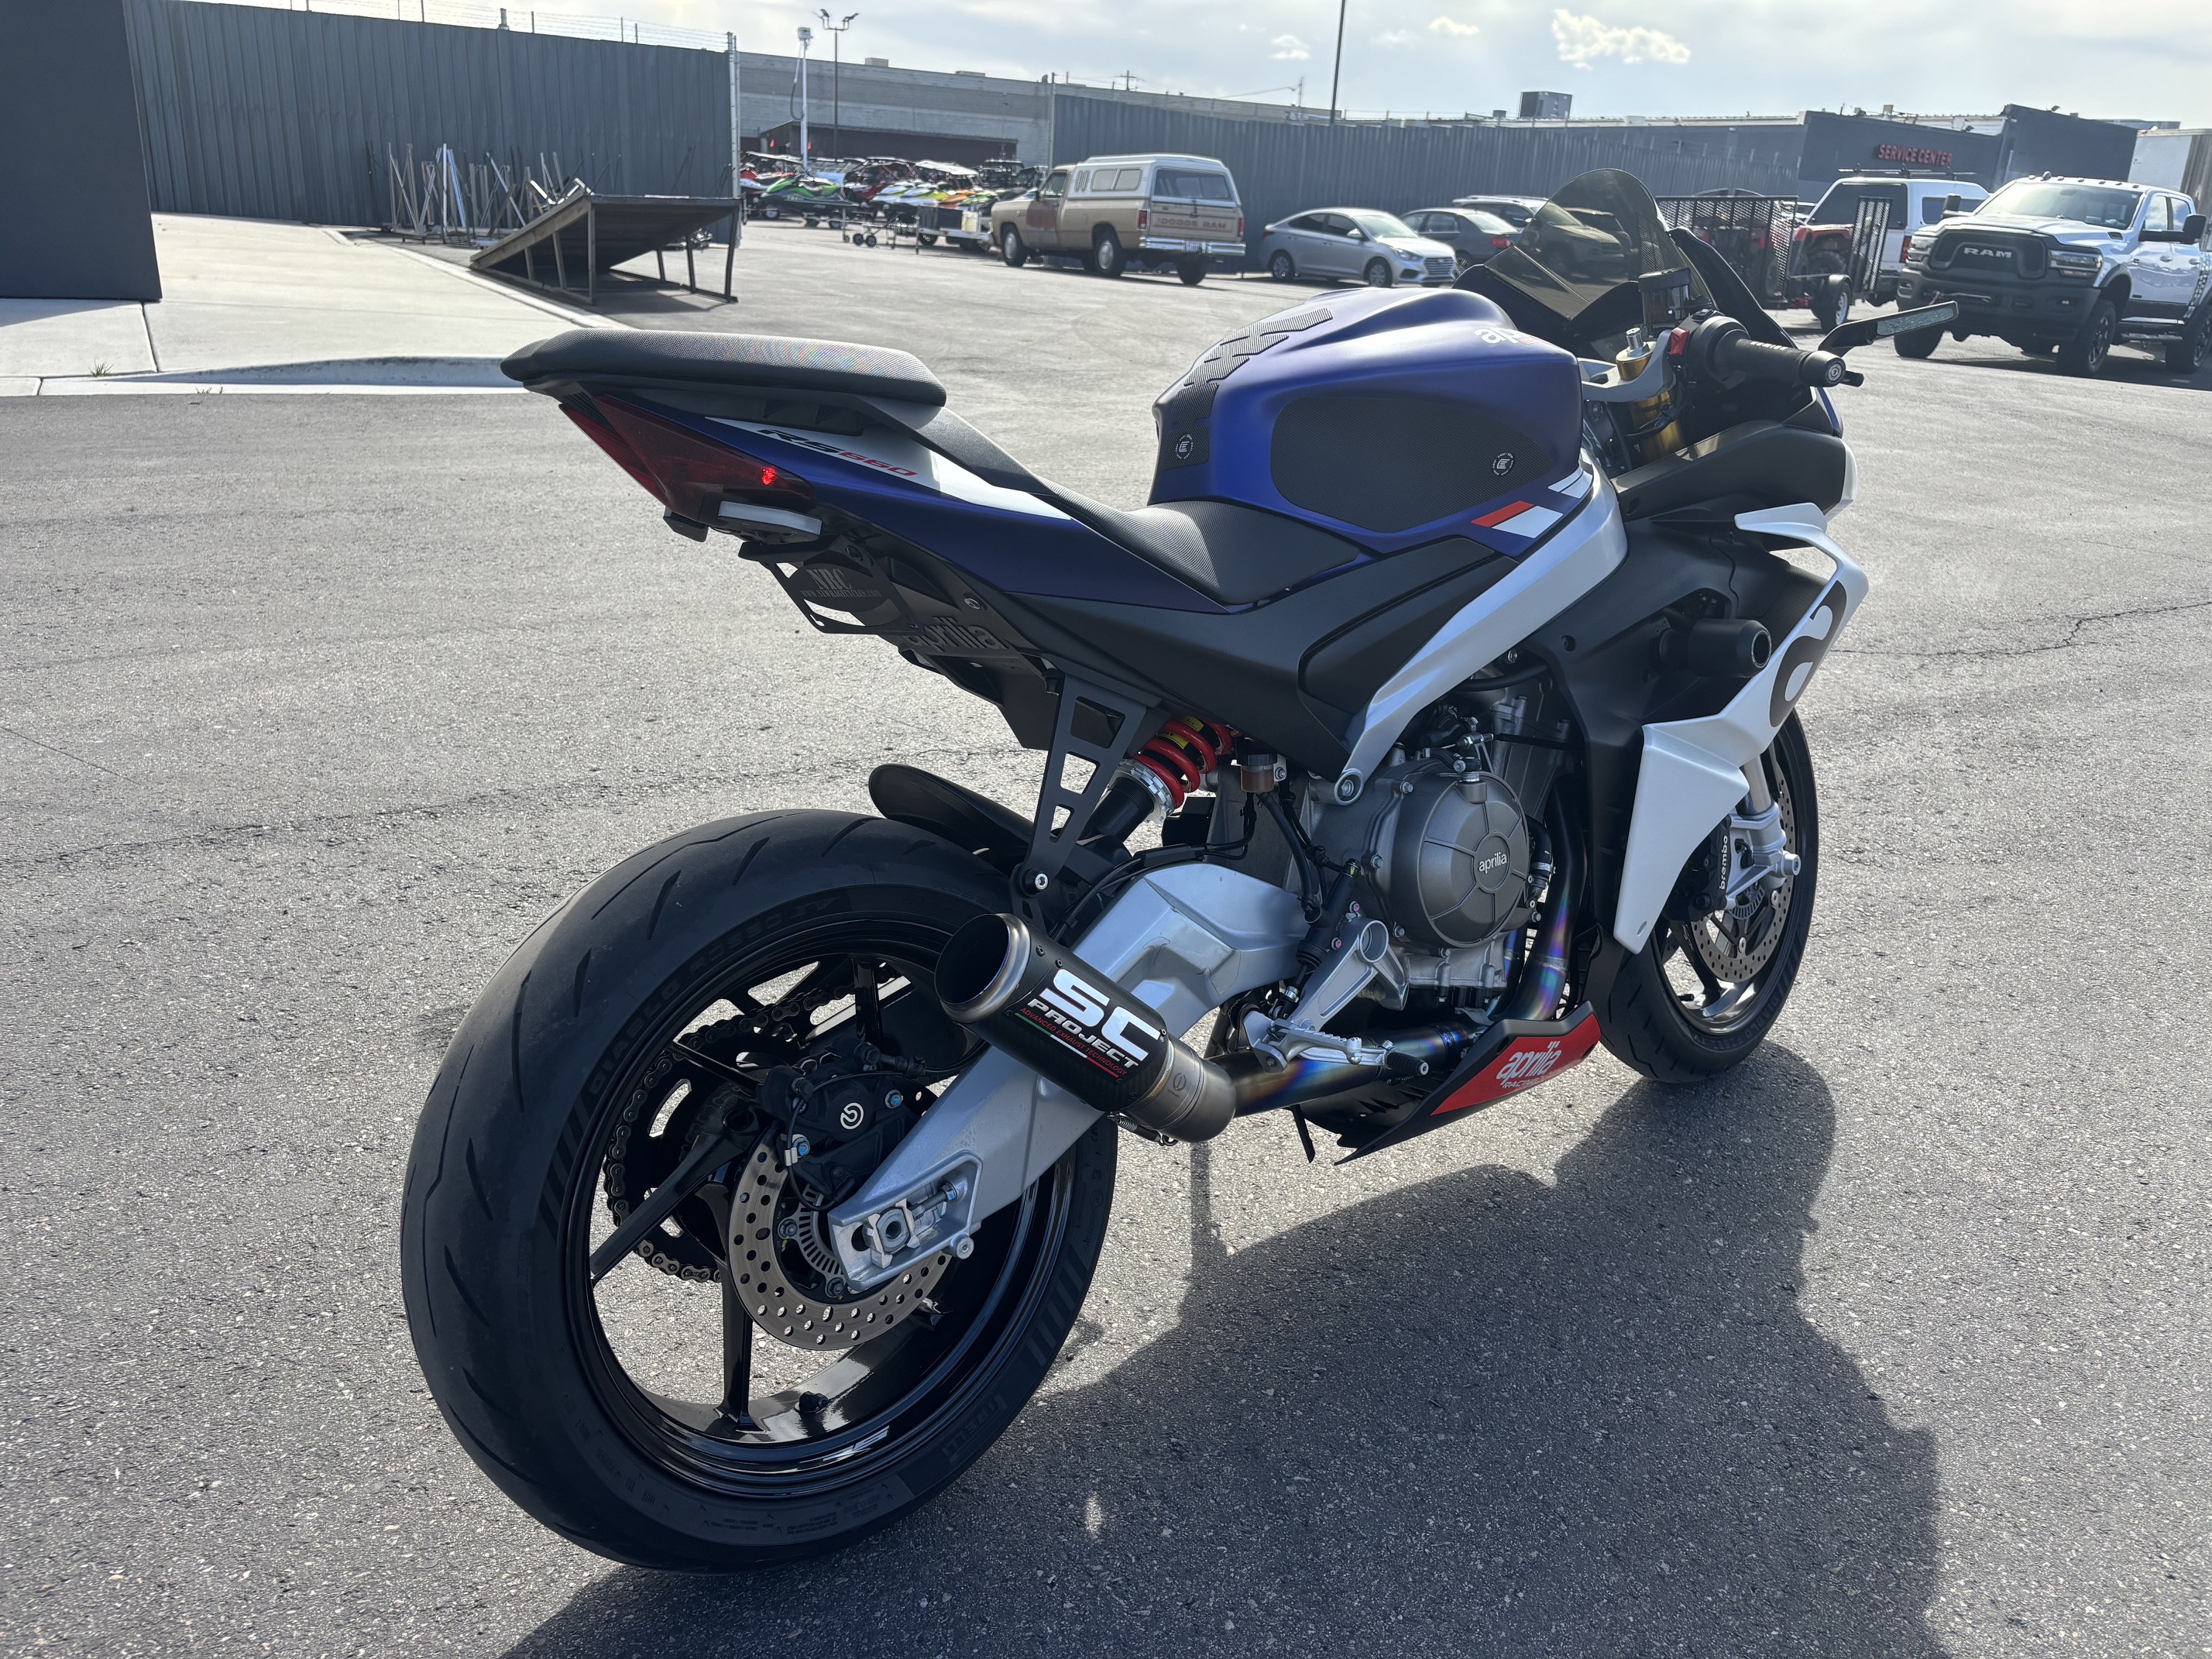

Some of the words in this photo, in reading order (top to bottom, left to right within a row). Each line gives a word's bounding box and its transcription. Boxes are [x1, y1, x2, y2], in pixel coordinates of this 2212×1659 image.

[1878, 143, 1918, 162] SERVICE
[1918, 149, 1953, 167] CENTER
[1161, 218, 1199, 227] DODGE
[1963, 247, 2012, 258] RAM
[806, 568, 852, 590] NRC
[1479, 851, 1507, 874] aprilia
[1719, 835, 1728, 890] brembo
[1039, 968, 1161, 1062] SC
[1019, 1007, 1056, 1032] ADVANCED
[1056, 1029, 1087, 1049] EXHAUST
[1085, 1046, 1128, 1076] TECHNOLOGY
[1027, 998, 1139, 1069] PROJECT
[1496, 1041, 1562, 1086] aprilia
